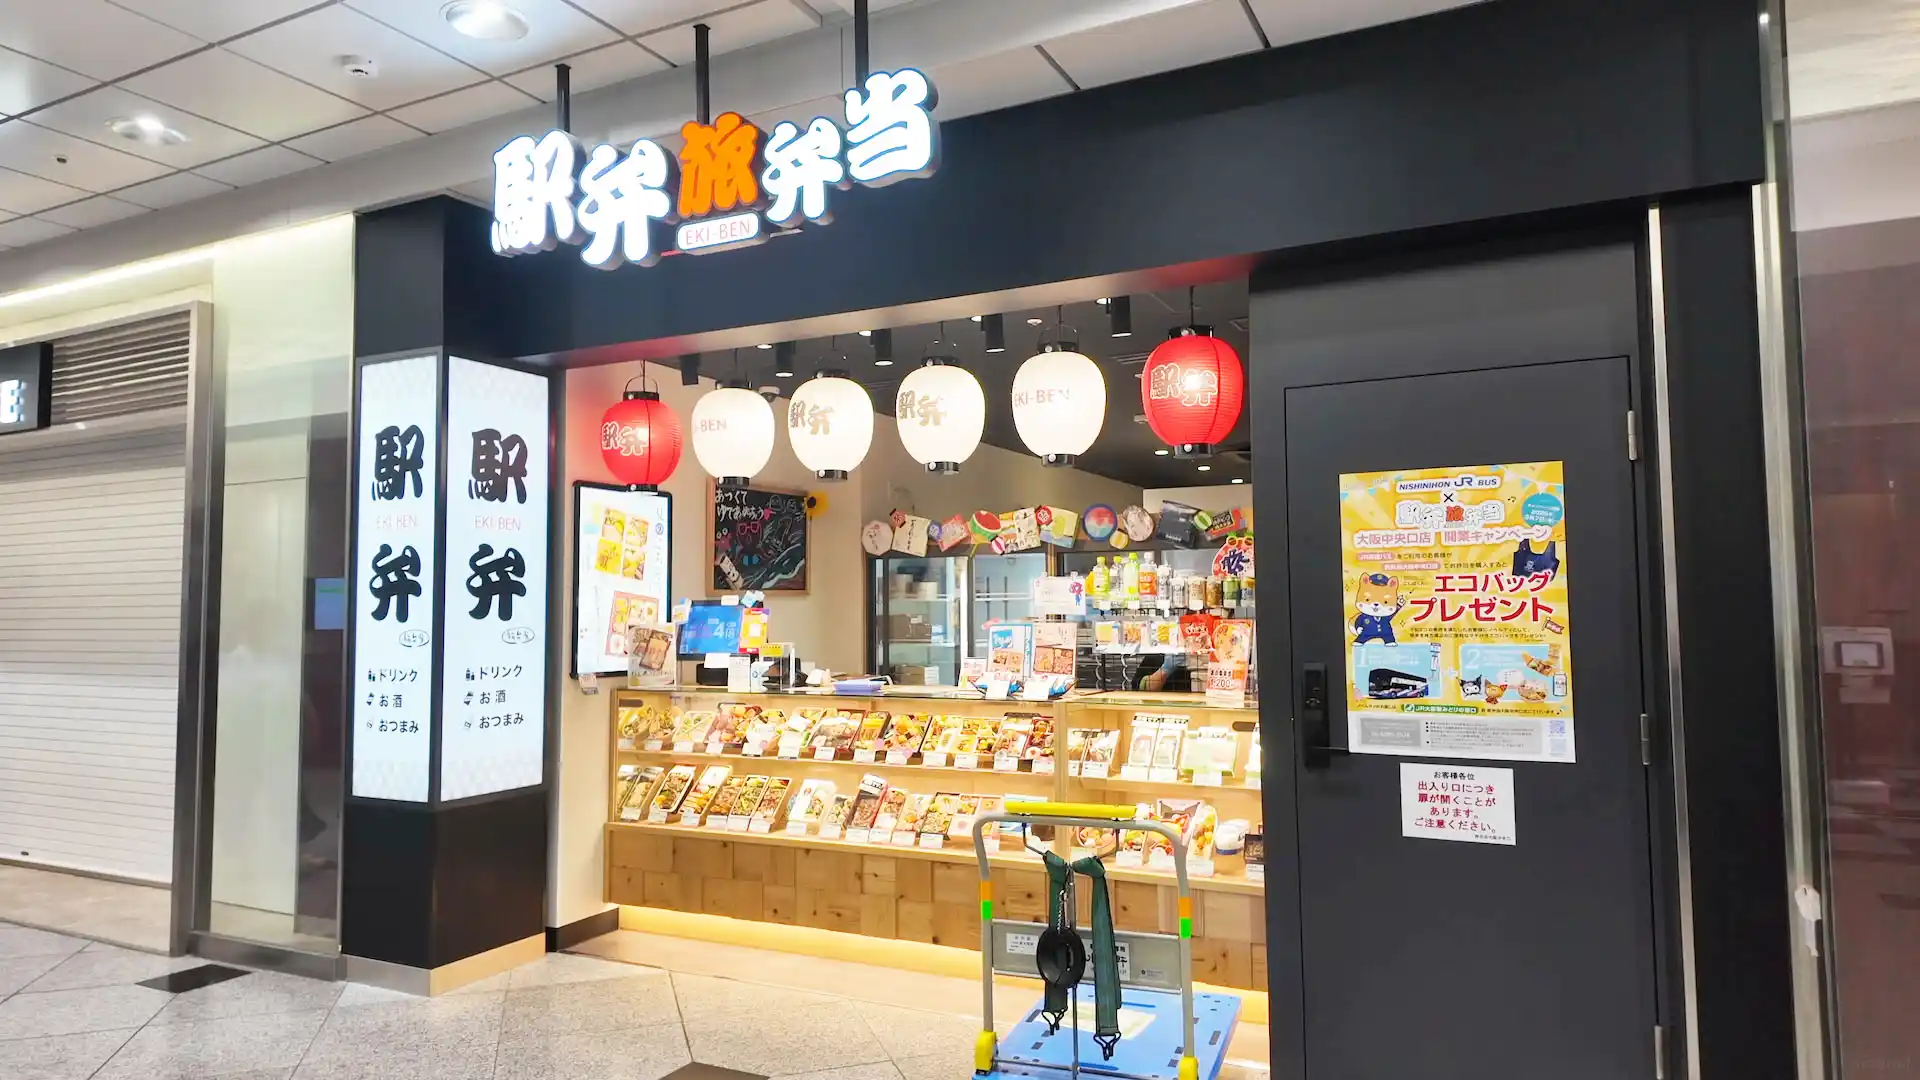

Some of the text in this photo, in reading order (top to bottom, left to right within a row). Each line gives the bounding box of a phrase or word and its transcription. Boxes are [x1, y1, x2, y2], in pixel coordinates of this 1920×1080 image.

[684, 219, 751, 247] EKI-BEN
[789, 400, 836, 436] 駅弁
[601, 420, 650, 457] 駅弁
[1399, 476, 1498, 491] NISHINIHON JR BUS
[1356, 527, 1549, 545] 大阪中央口店 開業キャンペーン
[1434, 571, 1552, 593] エコバッグ
[1410, 596, 1554, 623] プレゼント
[379, 668, 418, 683] ドリンク
[479, 664, 523, 681] ドリンク
[379, 693, 403, 708] お酒
[479, 689, 507, 705] お酒
[378, 720, 419, 734] おつまみ
[478, 712, 524, 729] おつまみ
[1433, 771, 1475, 781] お客様各位
[1417, 781, 1496, 795] 出入り口につき
[1417, 793, 1496, 807] 扉が開くことが
[1430, 806, 1479, 819] あります。
[1413, 817, 1496, 834] ご注意ください。
